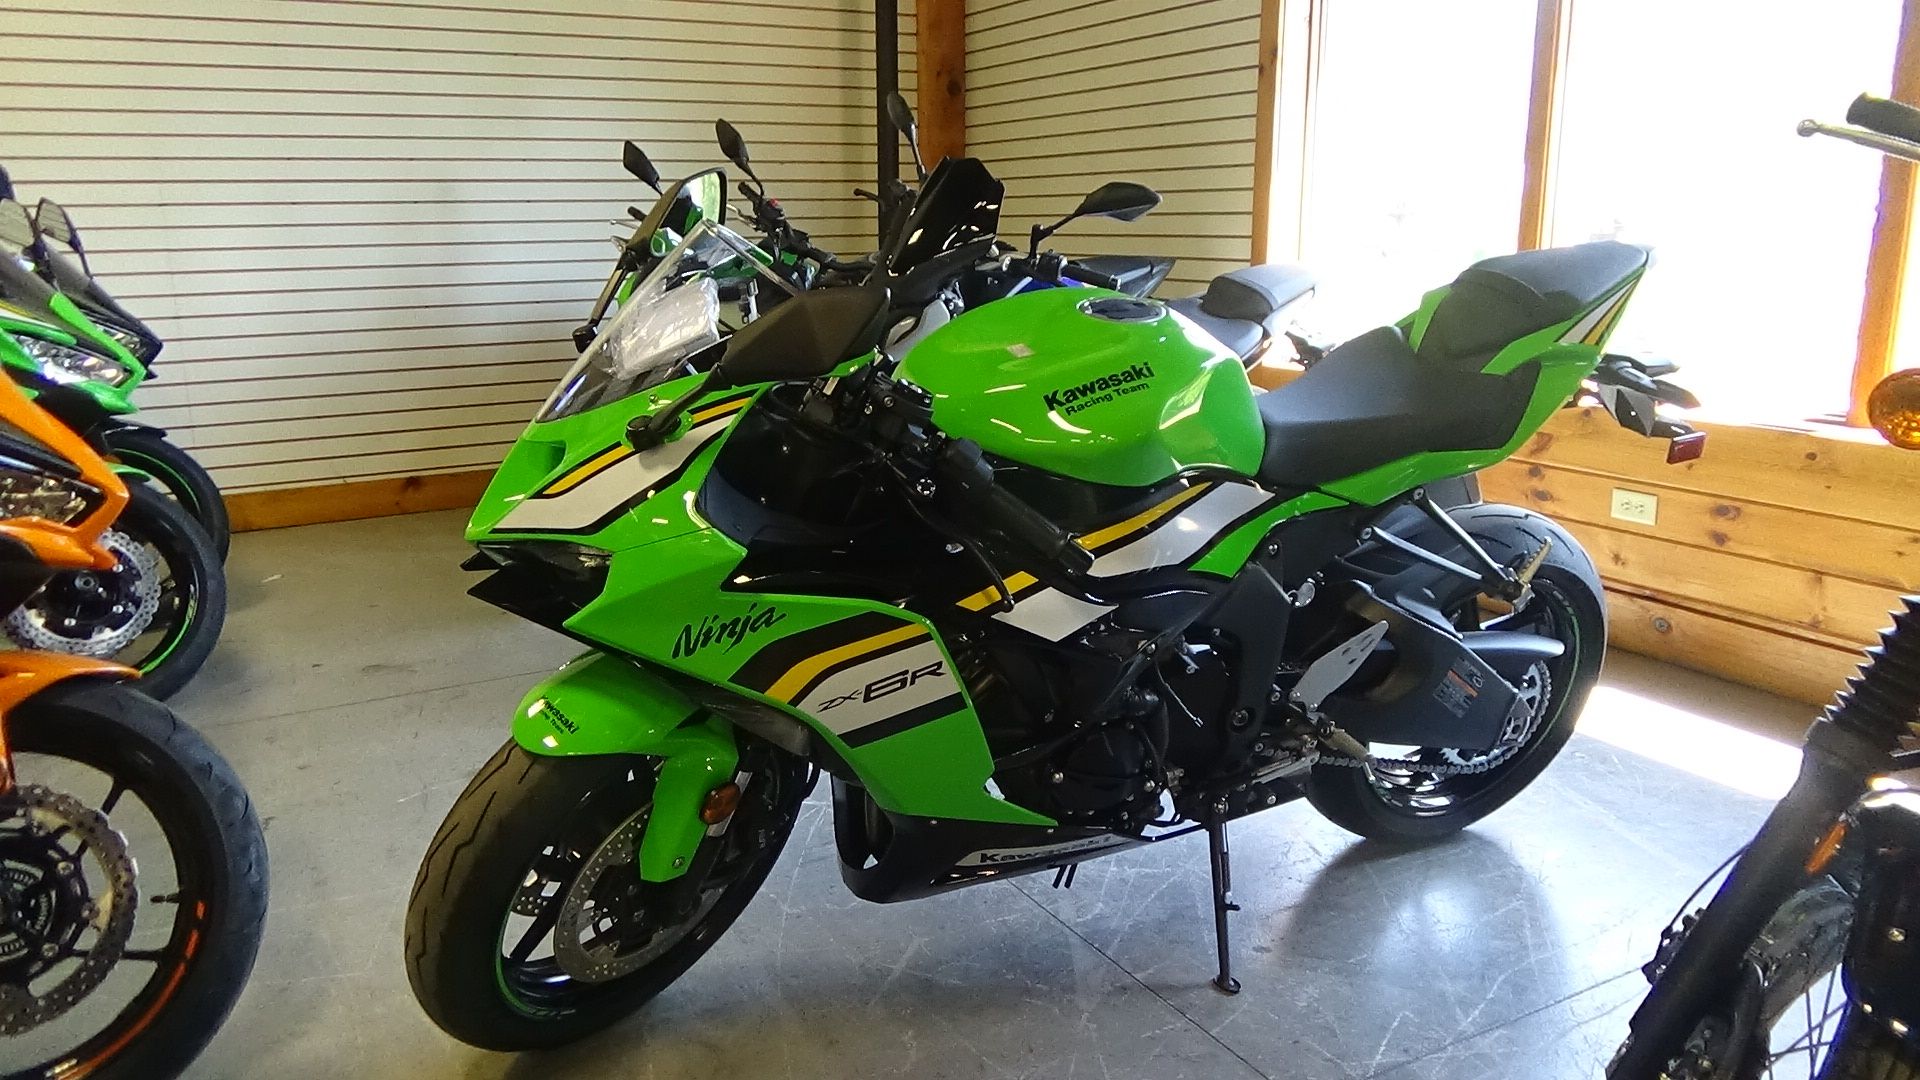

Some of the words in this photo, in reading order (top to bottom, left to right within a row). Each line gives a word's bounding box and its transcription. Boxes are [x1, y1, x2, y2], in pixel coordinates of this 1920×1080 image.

[1043, 361, 1155, 411] Kawasaki
[1065, 392, 1114, 416] Racing
[1113, 382, 1150, 396] Team
[671, 602, 787, 659] Ninja
[816, 660, 947, 713] ZX-6R
[541, 695, 580, 735] wasaki
